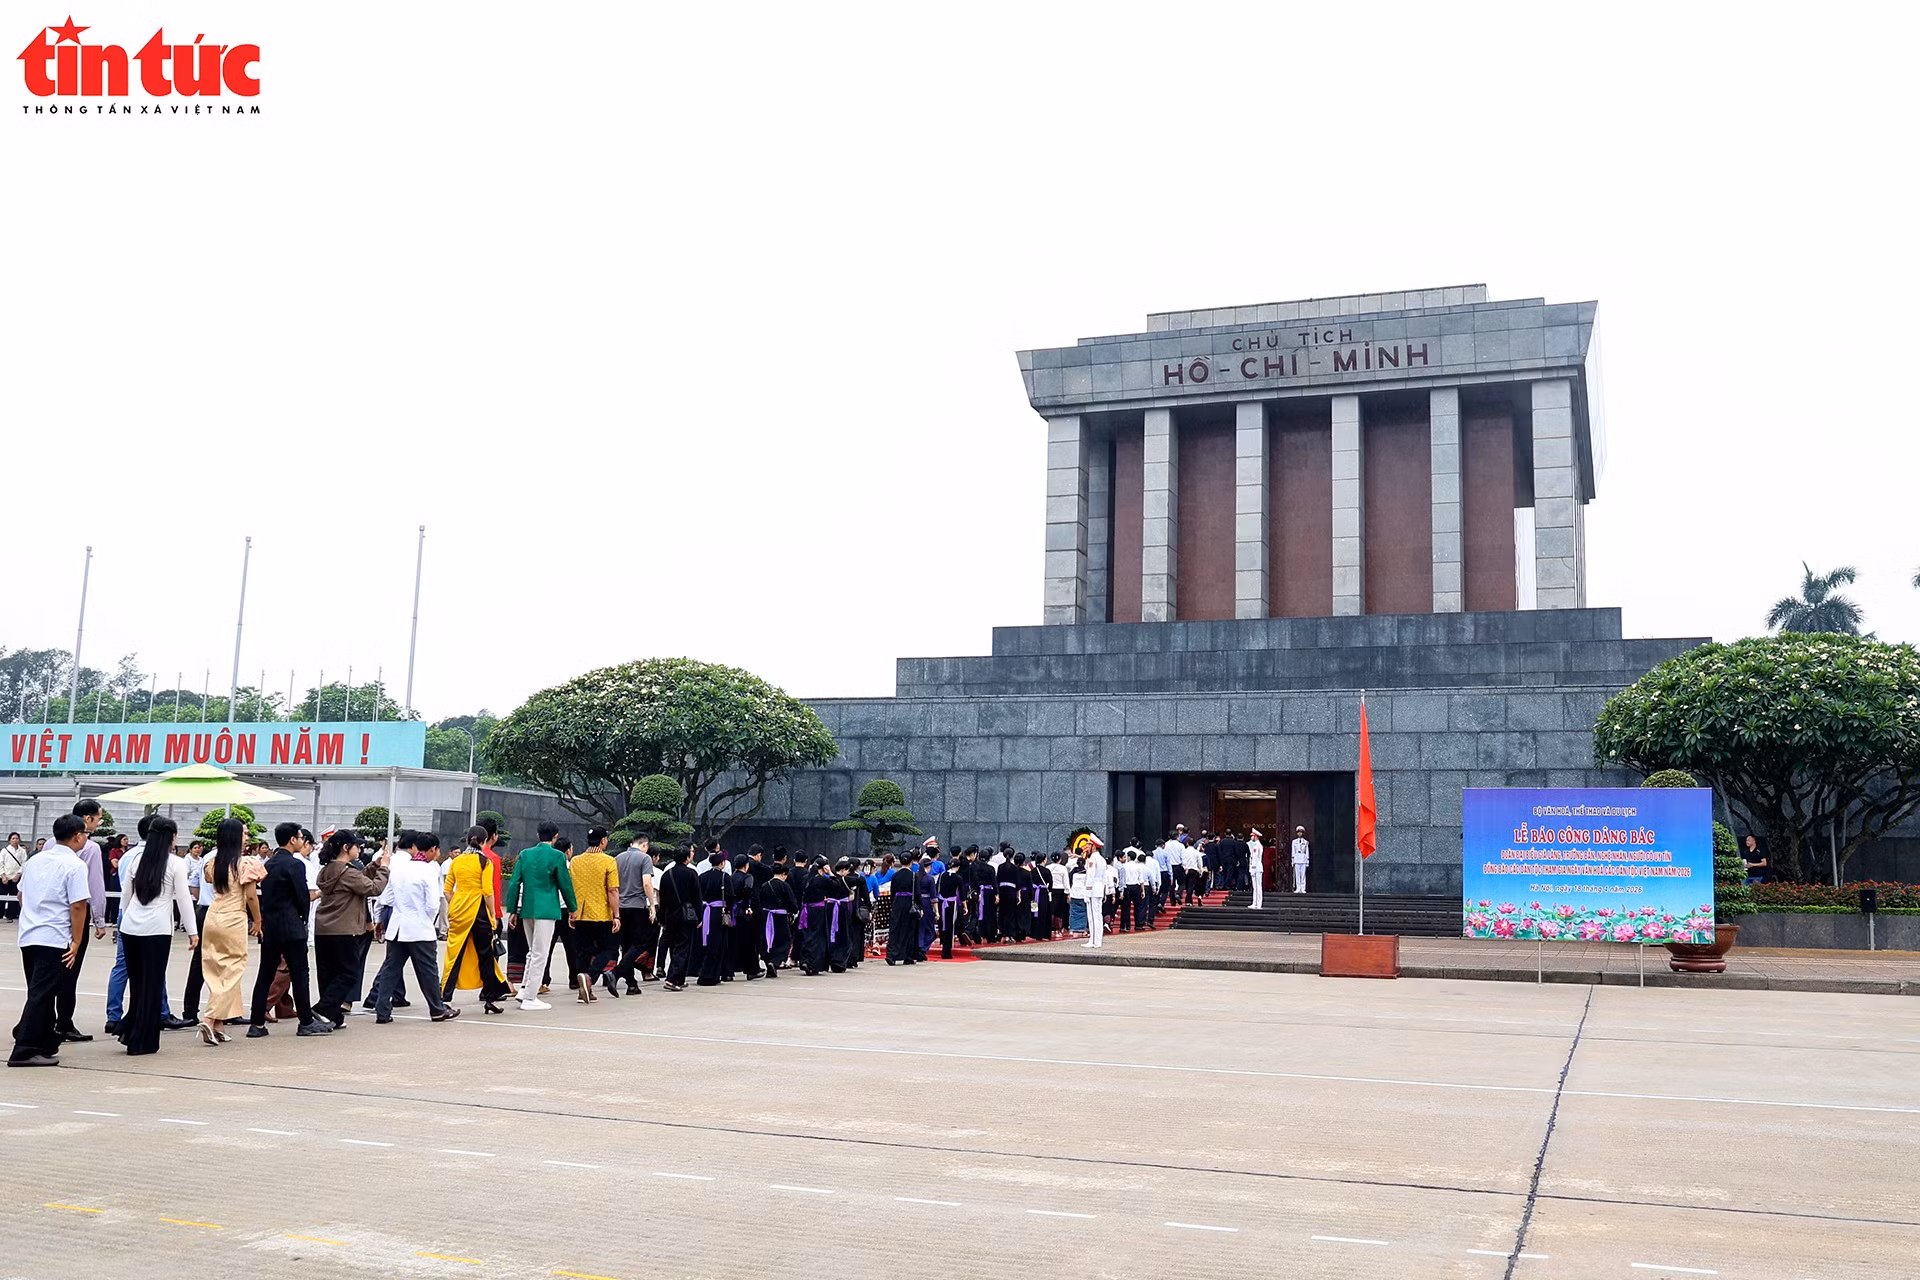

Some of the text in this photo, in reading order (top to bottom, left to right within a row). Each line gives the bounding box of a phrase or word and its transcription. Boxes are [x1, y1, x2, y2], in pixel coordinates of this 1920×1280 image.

[1232, 327, 1354, 351] CHỦ TỊCH
[1163, 356, 1211, 386] HỒ
[1240, 348, 1300, 379] CHÍ
[1333, 341, 1429, 373] MINH
[11, 728, 72, 769] VIỆT
[84, 733, 152, 764] NAM
[164, 727, 257, 765] MUÔN
[270, 726, 345, 766] NĂM
[1533, 805, 1542, 817] BỘ
[1585, 807, 1601, 816] THAO
[1602, 806, 1611, 816] VÀ
[1622, 807, 1637, 818] LỊCH
[1514, 822, 1655, 844] LỄ BÁO CÔNG DÂNG BÁC
